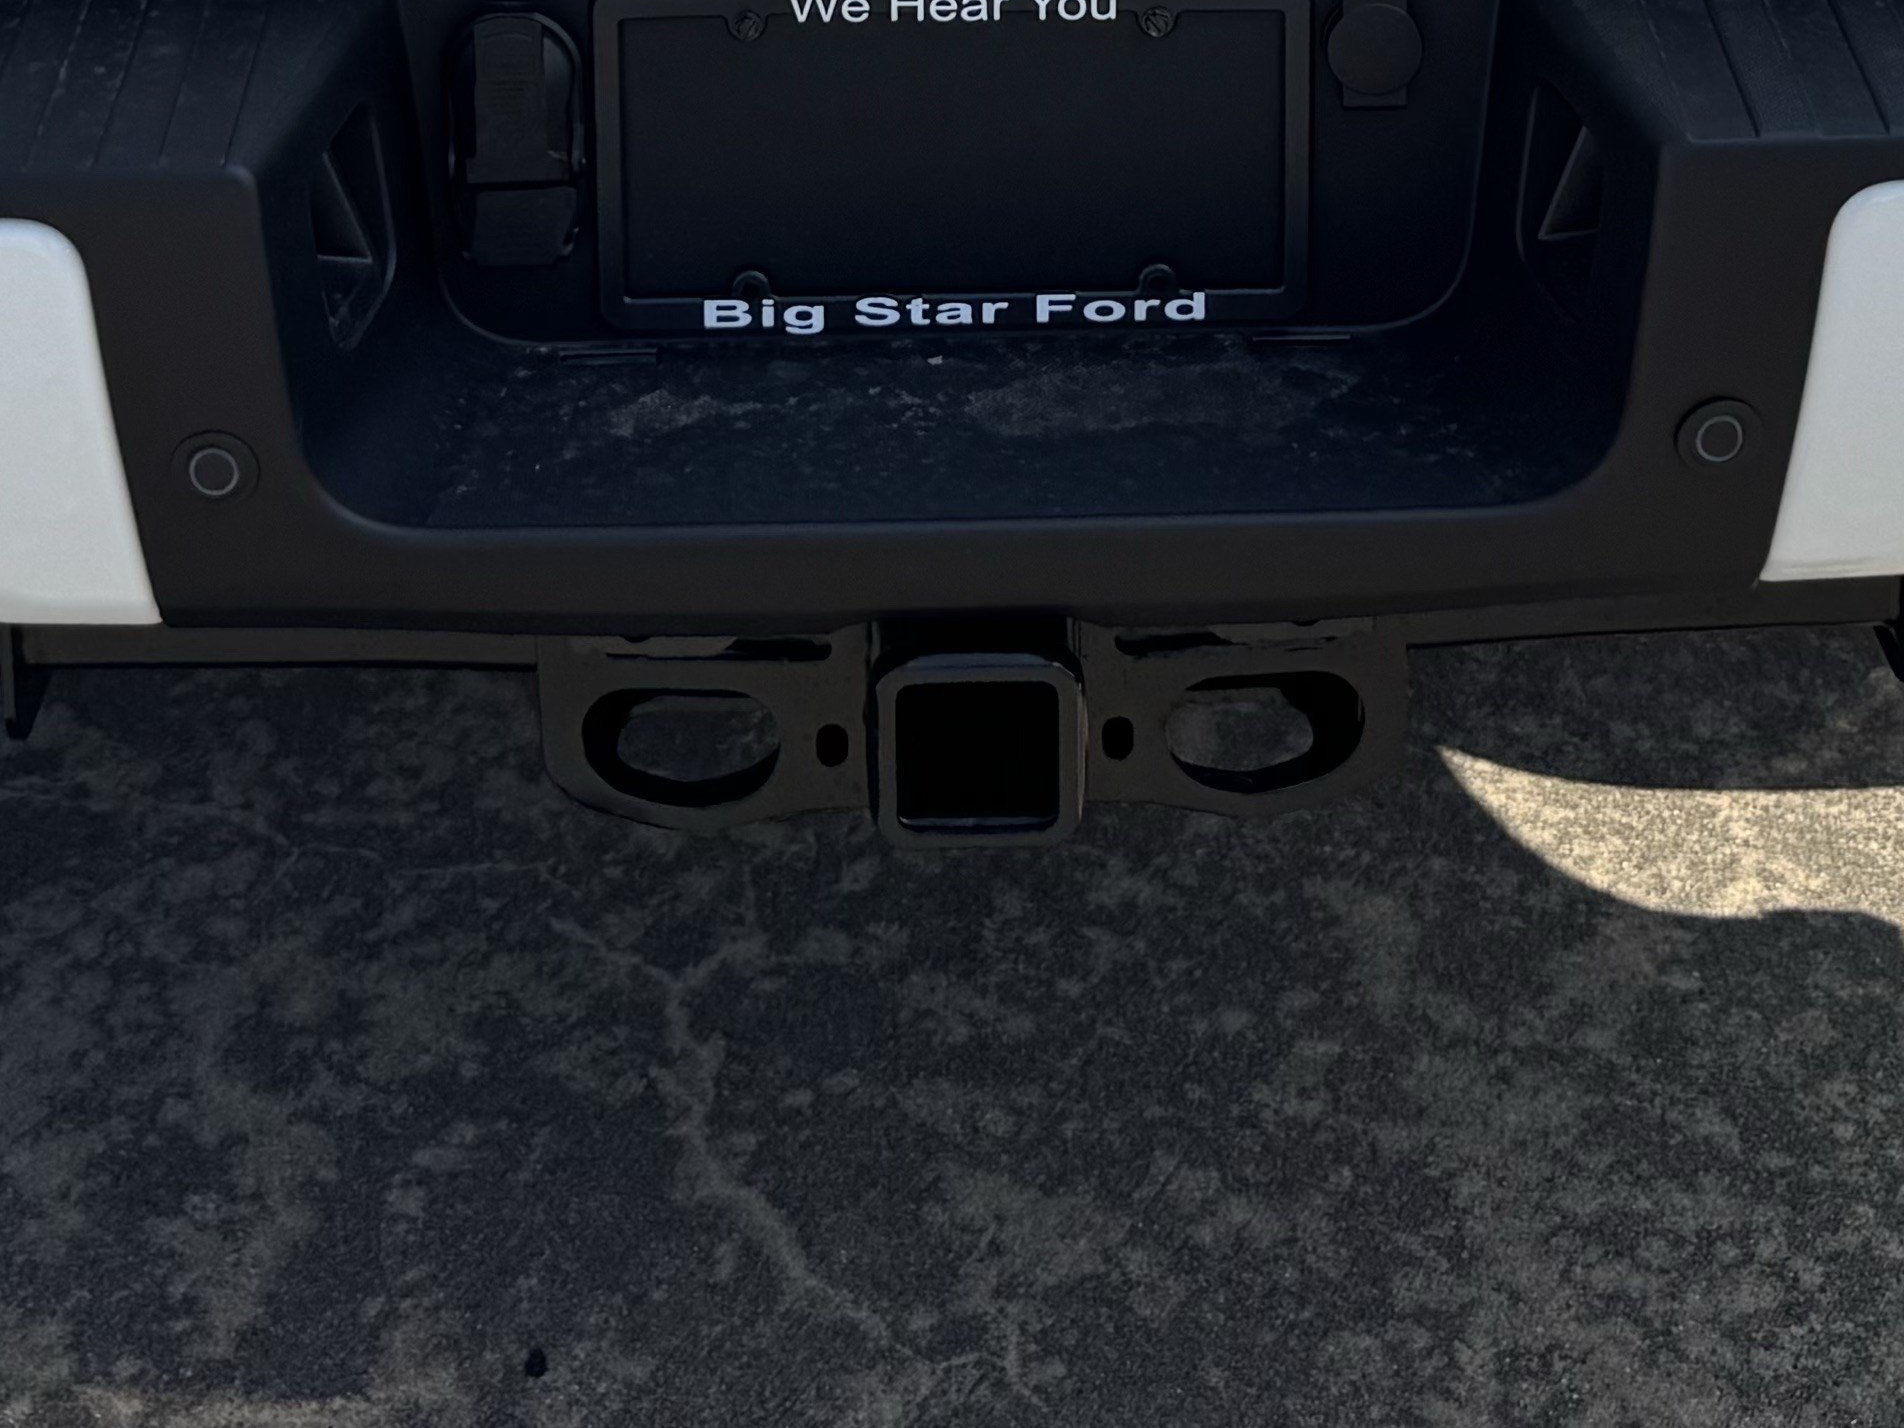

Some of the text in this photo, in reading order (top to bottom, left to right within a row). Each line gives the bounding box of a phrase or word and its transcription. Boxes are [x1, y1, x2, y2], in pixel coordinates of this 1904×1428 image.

[703, 291, 1206, 335] Big Star Ford
